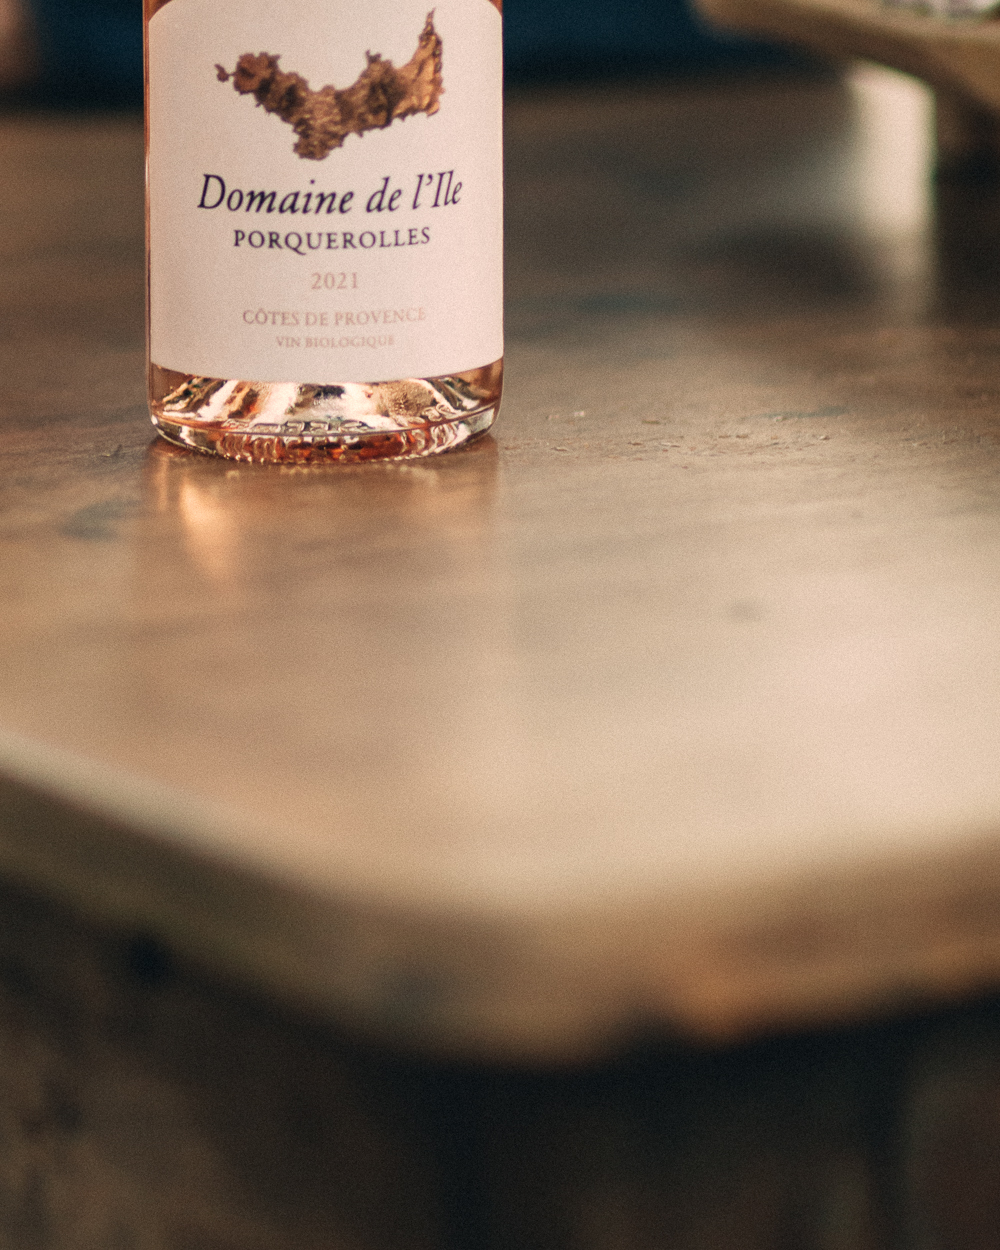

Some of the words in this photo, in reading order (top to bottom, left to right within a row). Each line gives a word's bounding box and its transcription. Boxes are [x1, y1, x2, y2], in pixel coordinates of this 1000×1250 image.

[197, 173, 355, 214] Domaine
[365, 176, 402, 213] de
[233, 227, 431, 256] PORQUEROLLES
[311, 272, 360, 290] 2021
[243, 307, 300, 327] CÔTES
[305, 311, 329, 327] DE
[334, 306, 427, 327] PROVENCE
[276, 336, 301, 349] VIN
[305, 334, 396, 350] BIOLOGIQUE
